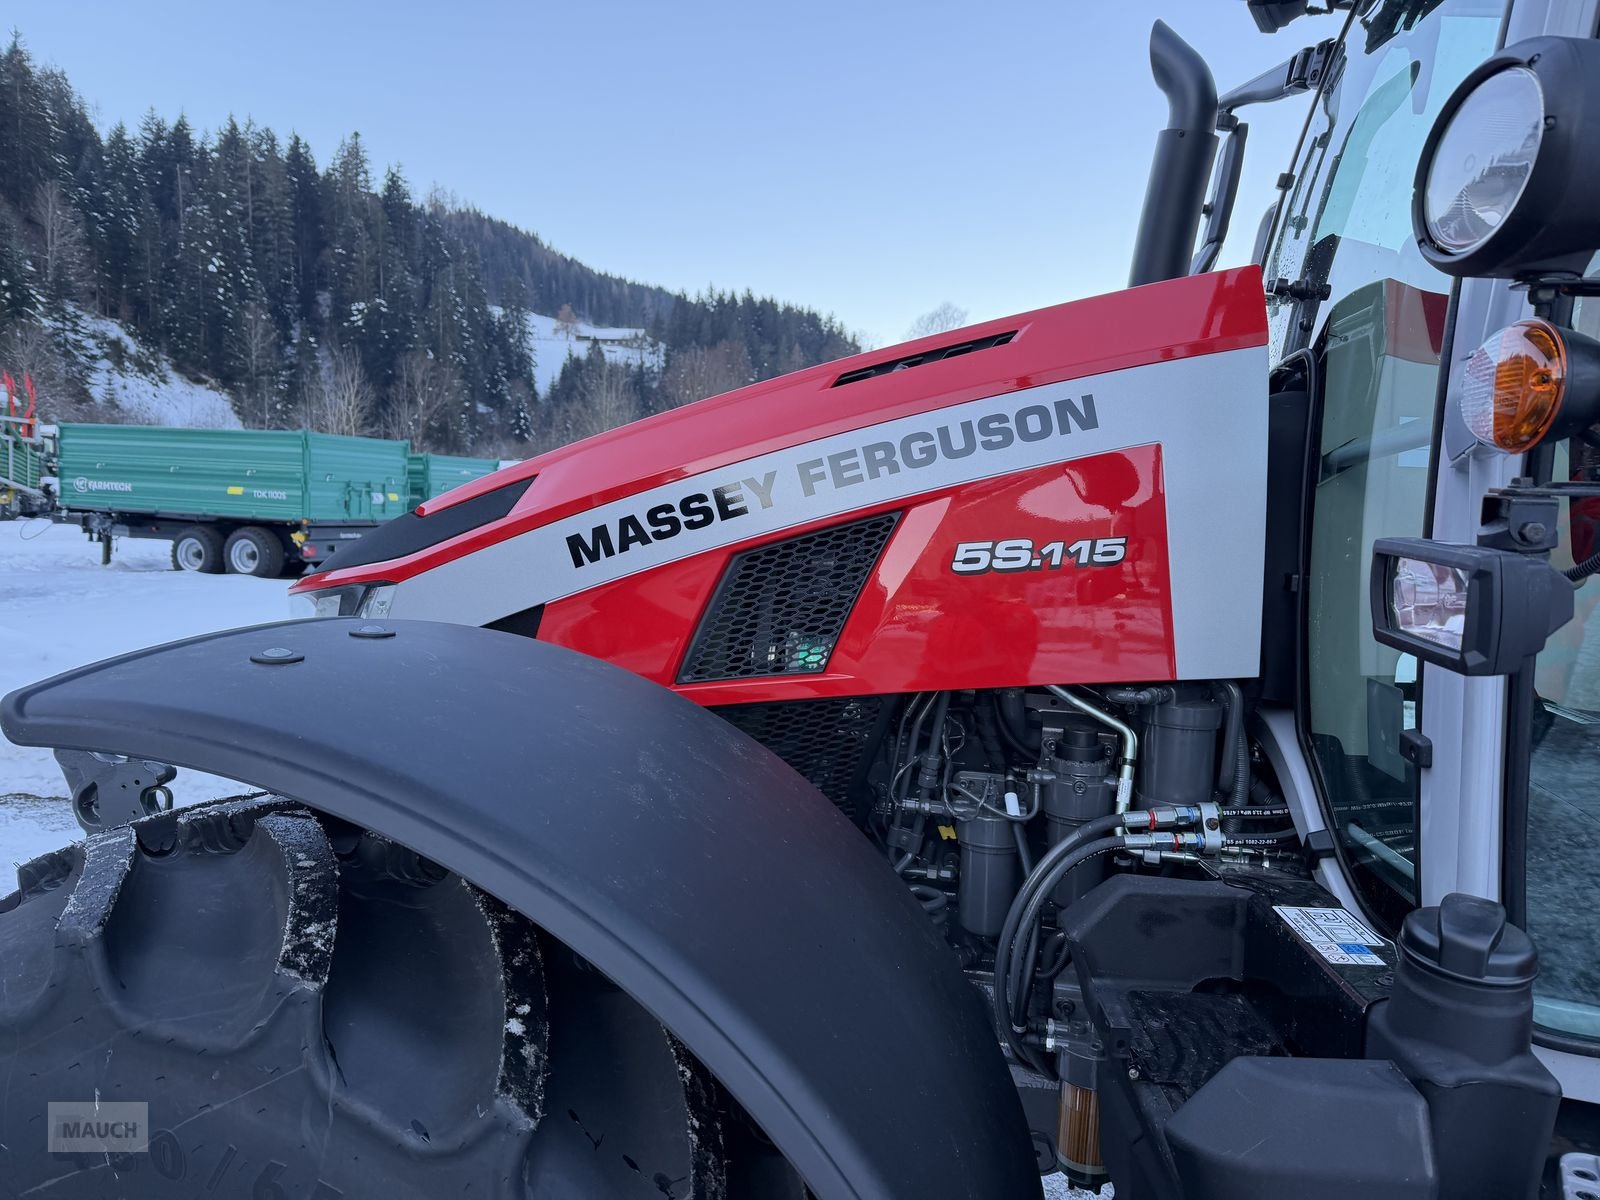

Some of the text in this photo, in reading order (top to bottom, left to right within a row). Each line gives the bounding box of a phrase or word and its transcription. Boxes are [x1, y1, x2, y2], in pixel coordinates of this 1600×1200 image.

[88, 480, 132, 492] FARMTECH
[565, 393, 1100, 569] MASSEY FERGUSON
[950, 535, 1129, 575] 5S.115
